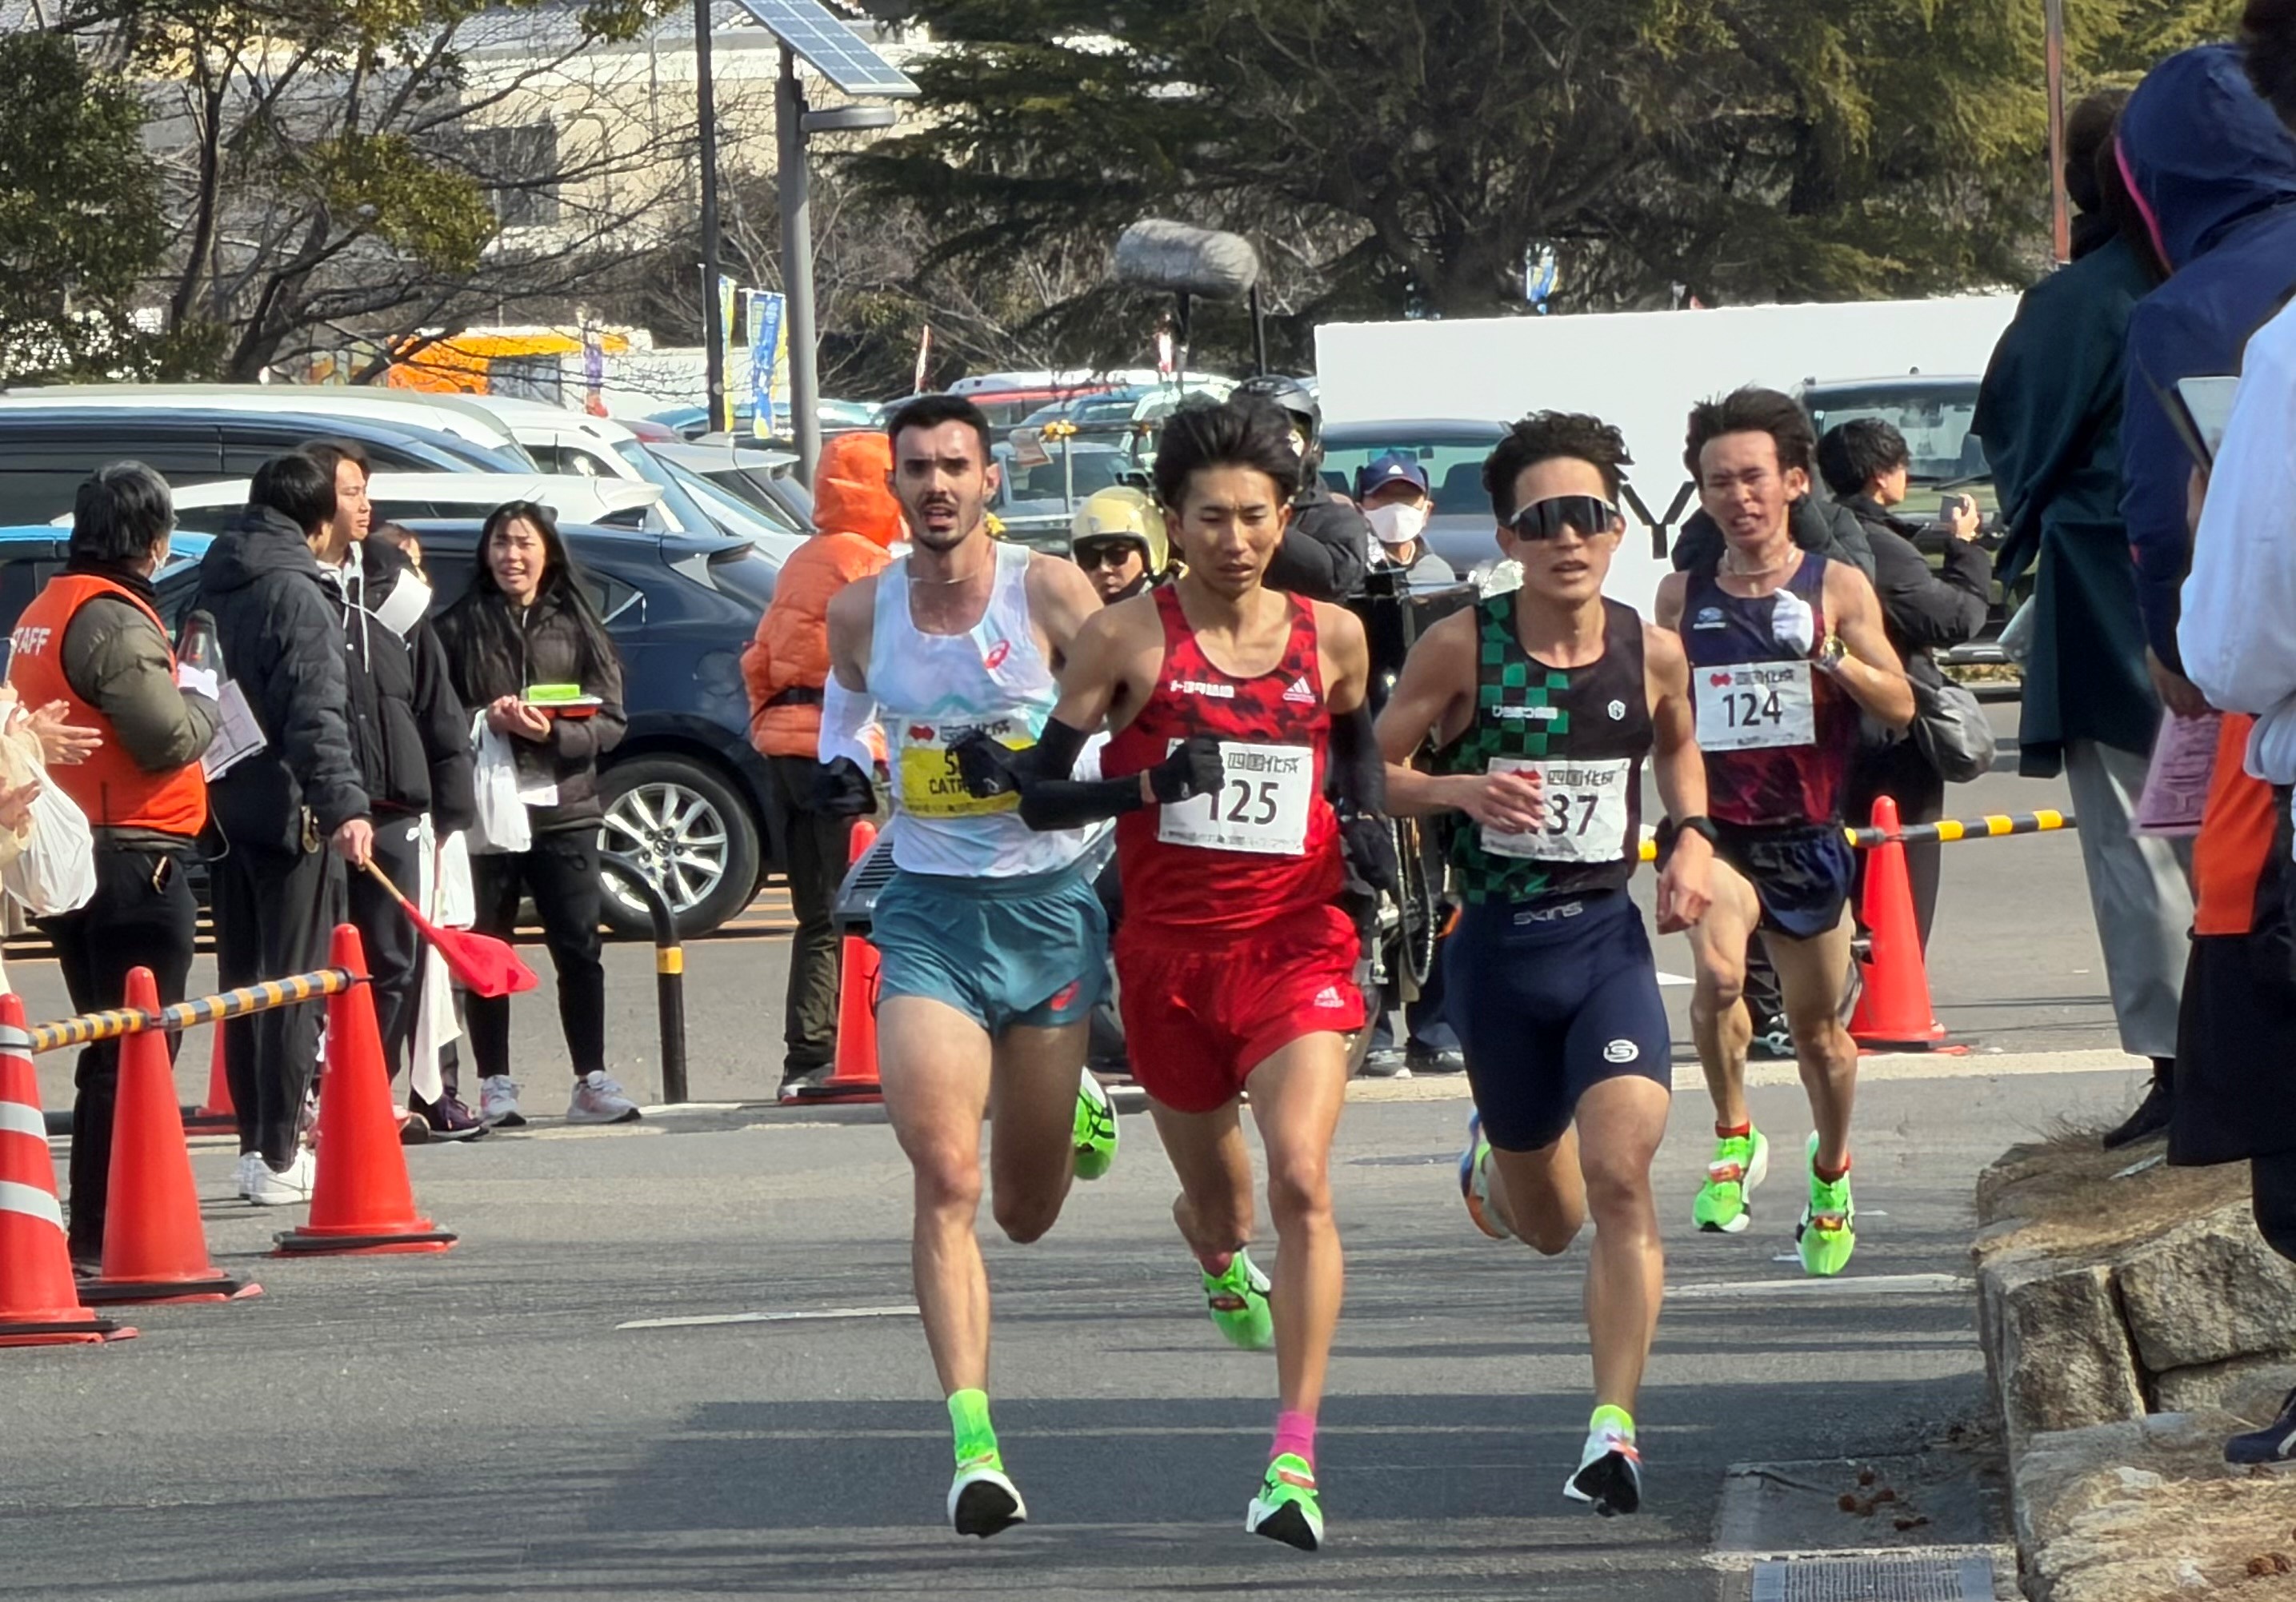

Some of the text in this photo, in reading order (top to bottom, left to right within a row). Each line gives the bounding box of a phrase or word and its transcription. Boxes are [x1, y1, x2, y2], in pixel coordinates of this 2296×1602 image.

[13, 627, 51, 656] TAFF
[1722, 690, 1782, 727] 124
[1210, 779, 1279, 825] 125
[1529, 793, 1598, 836] 37
